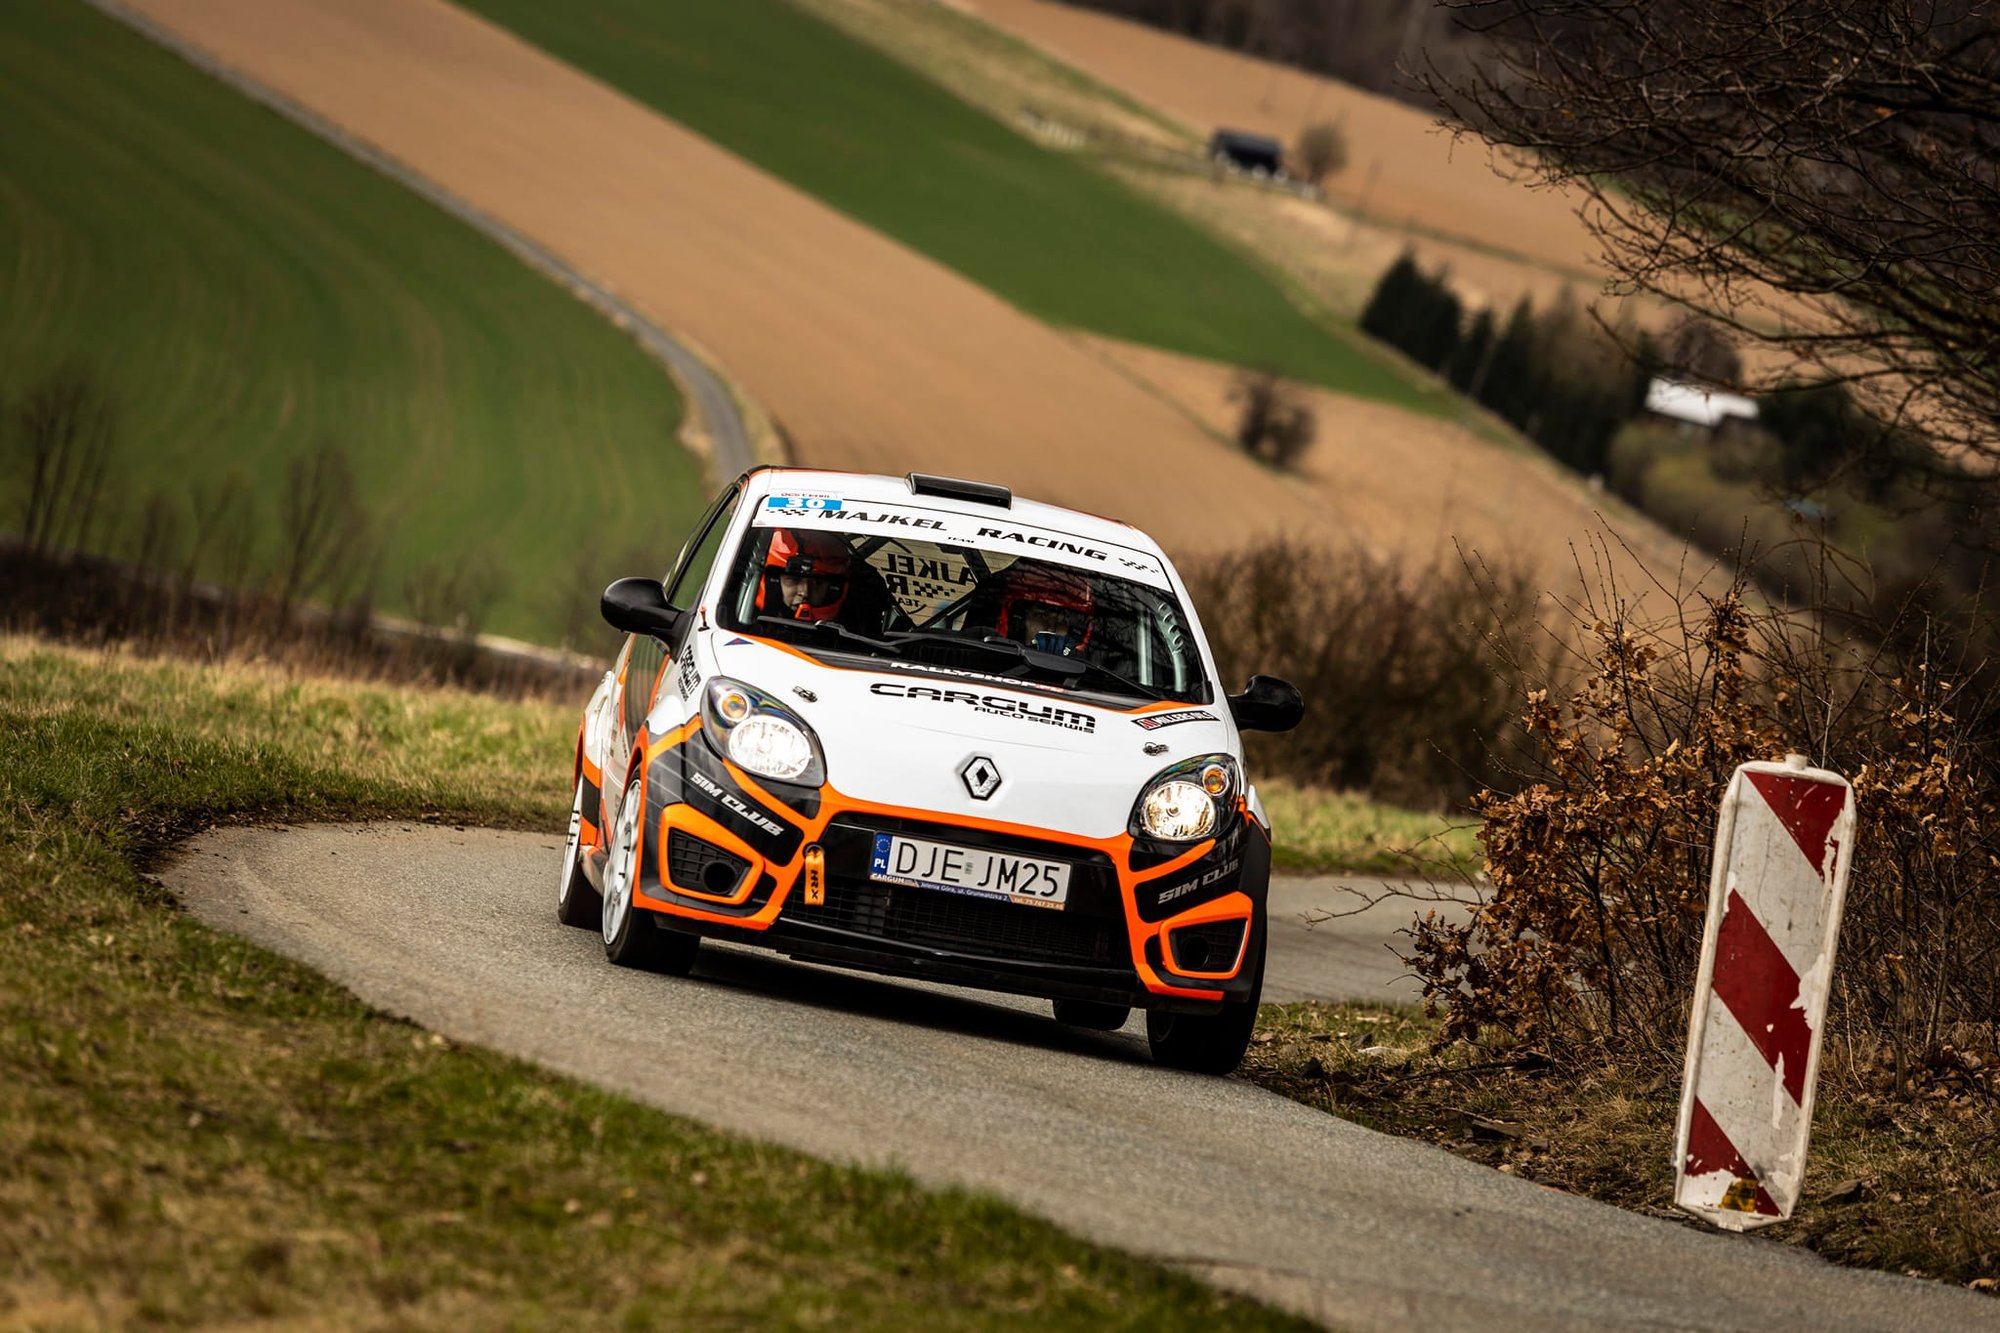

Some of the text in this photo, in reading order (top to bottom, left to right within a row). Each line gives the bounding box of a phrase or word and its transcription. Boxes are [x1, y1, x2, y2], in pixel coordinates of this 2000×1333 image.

[785, 498, 826, 509] 30
[818, 509, 1108, 561] MAJKEL RACING
[869, 682, 1096, 729] CARGUM
[973, 706, 1095, 734] AUTO SERWIS
[690, 771, 785, 836] SIM CLUB
[870, 873, 905, 885] CARGUM
[873, 858, 887, 869] PL
[896, 841, 1060, 897] DJE JM25
[1157, 859, 1239, 905] SIM CLUB
[810, 869, 820, 900] HRX
